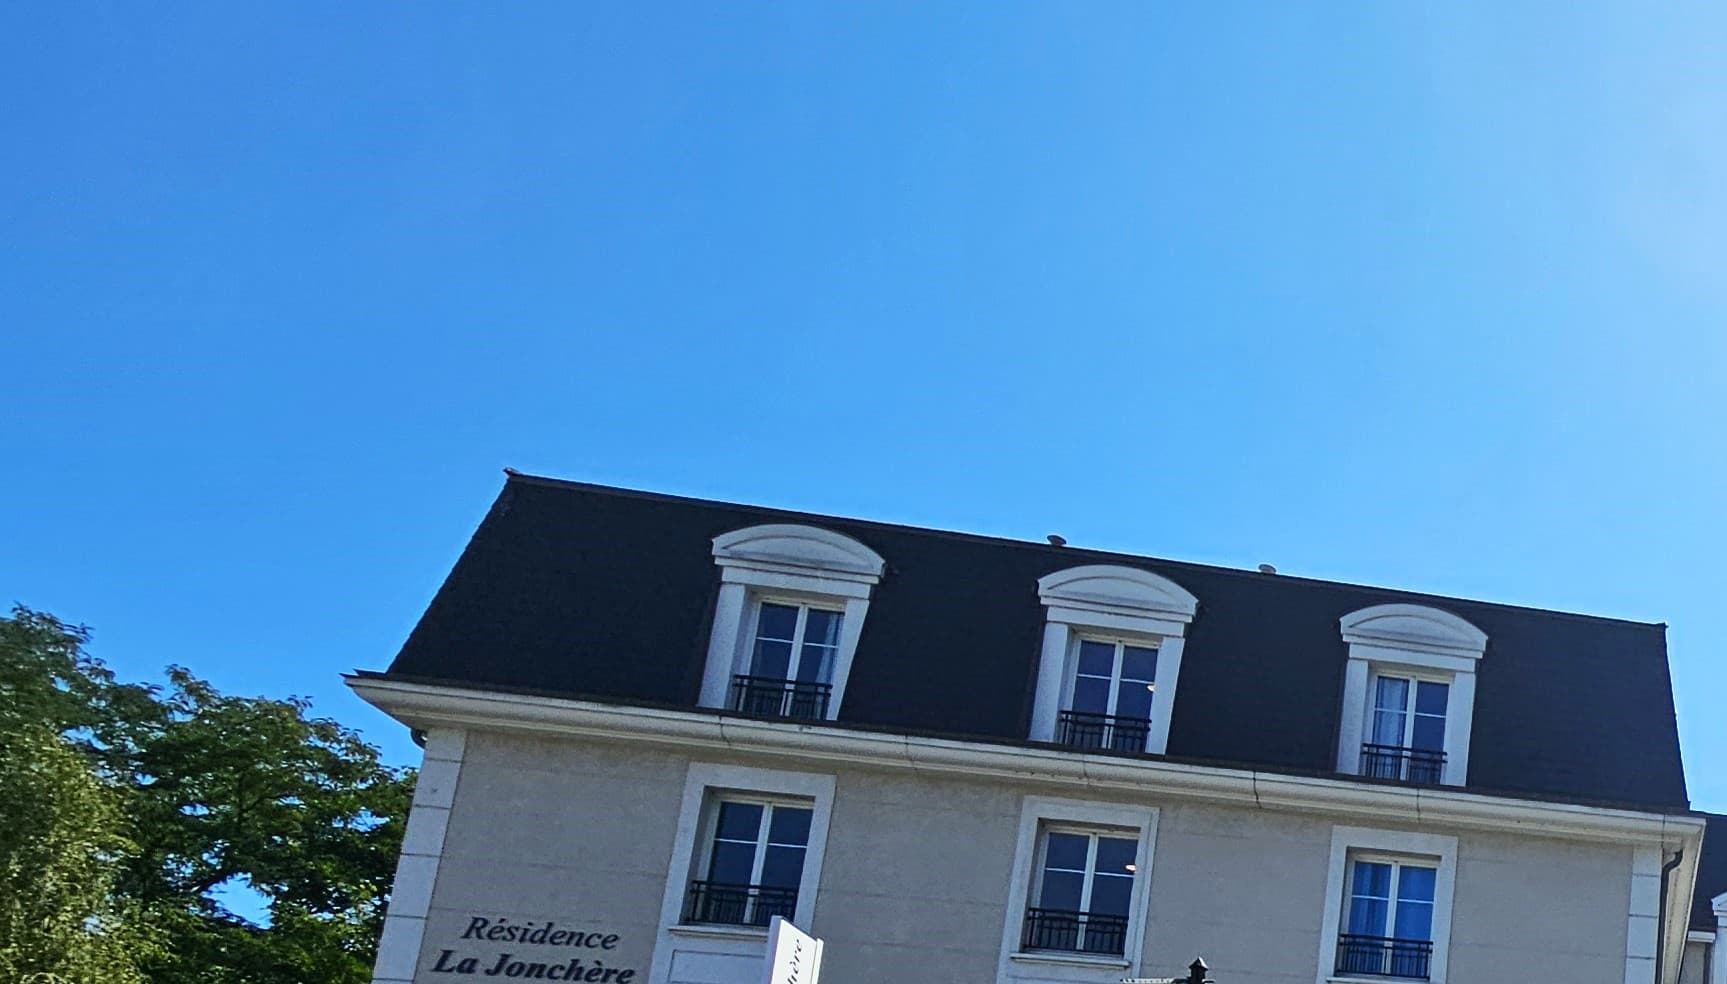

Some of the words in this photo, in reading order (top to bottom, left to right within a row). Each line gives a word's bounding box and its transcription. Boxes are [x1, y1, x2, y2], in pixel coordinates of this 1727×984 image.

[460, 916, 620, 951] Résidence
[431, 949, 479, 974] La
[486, 953, 636, 984] Jonchère
